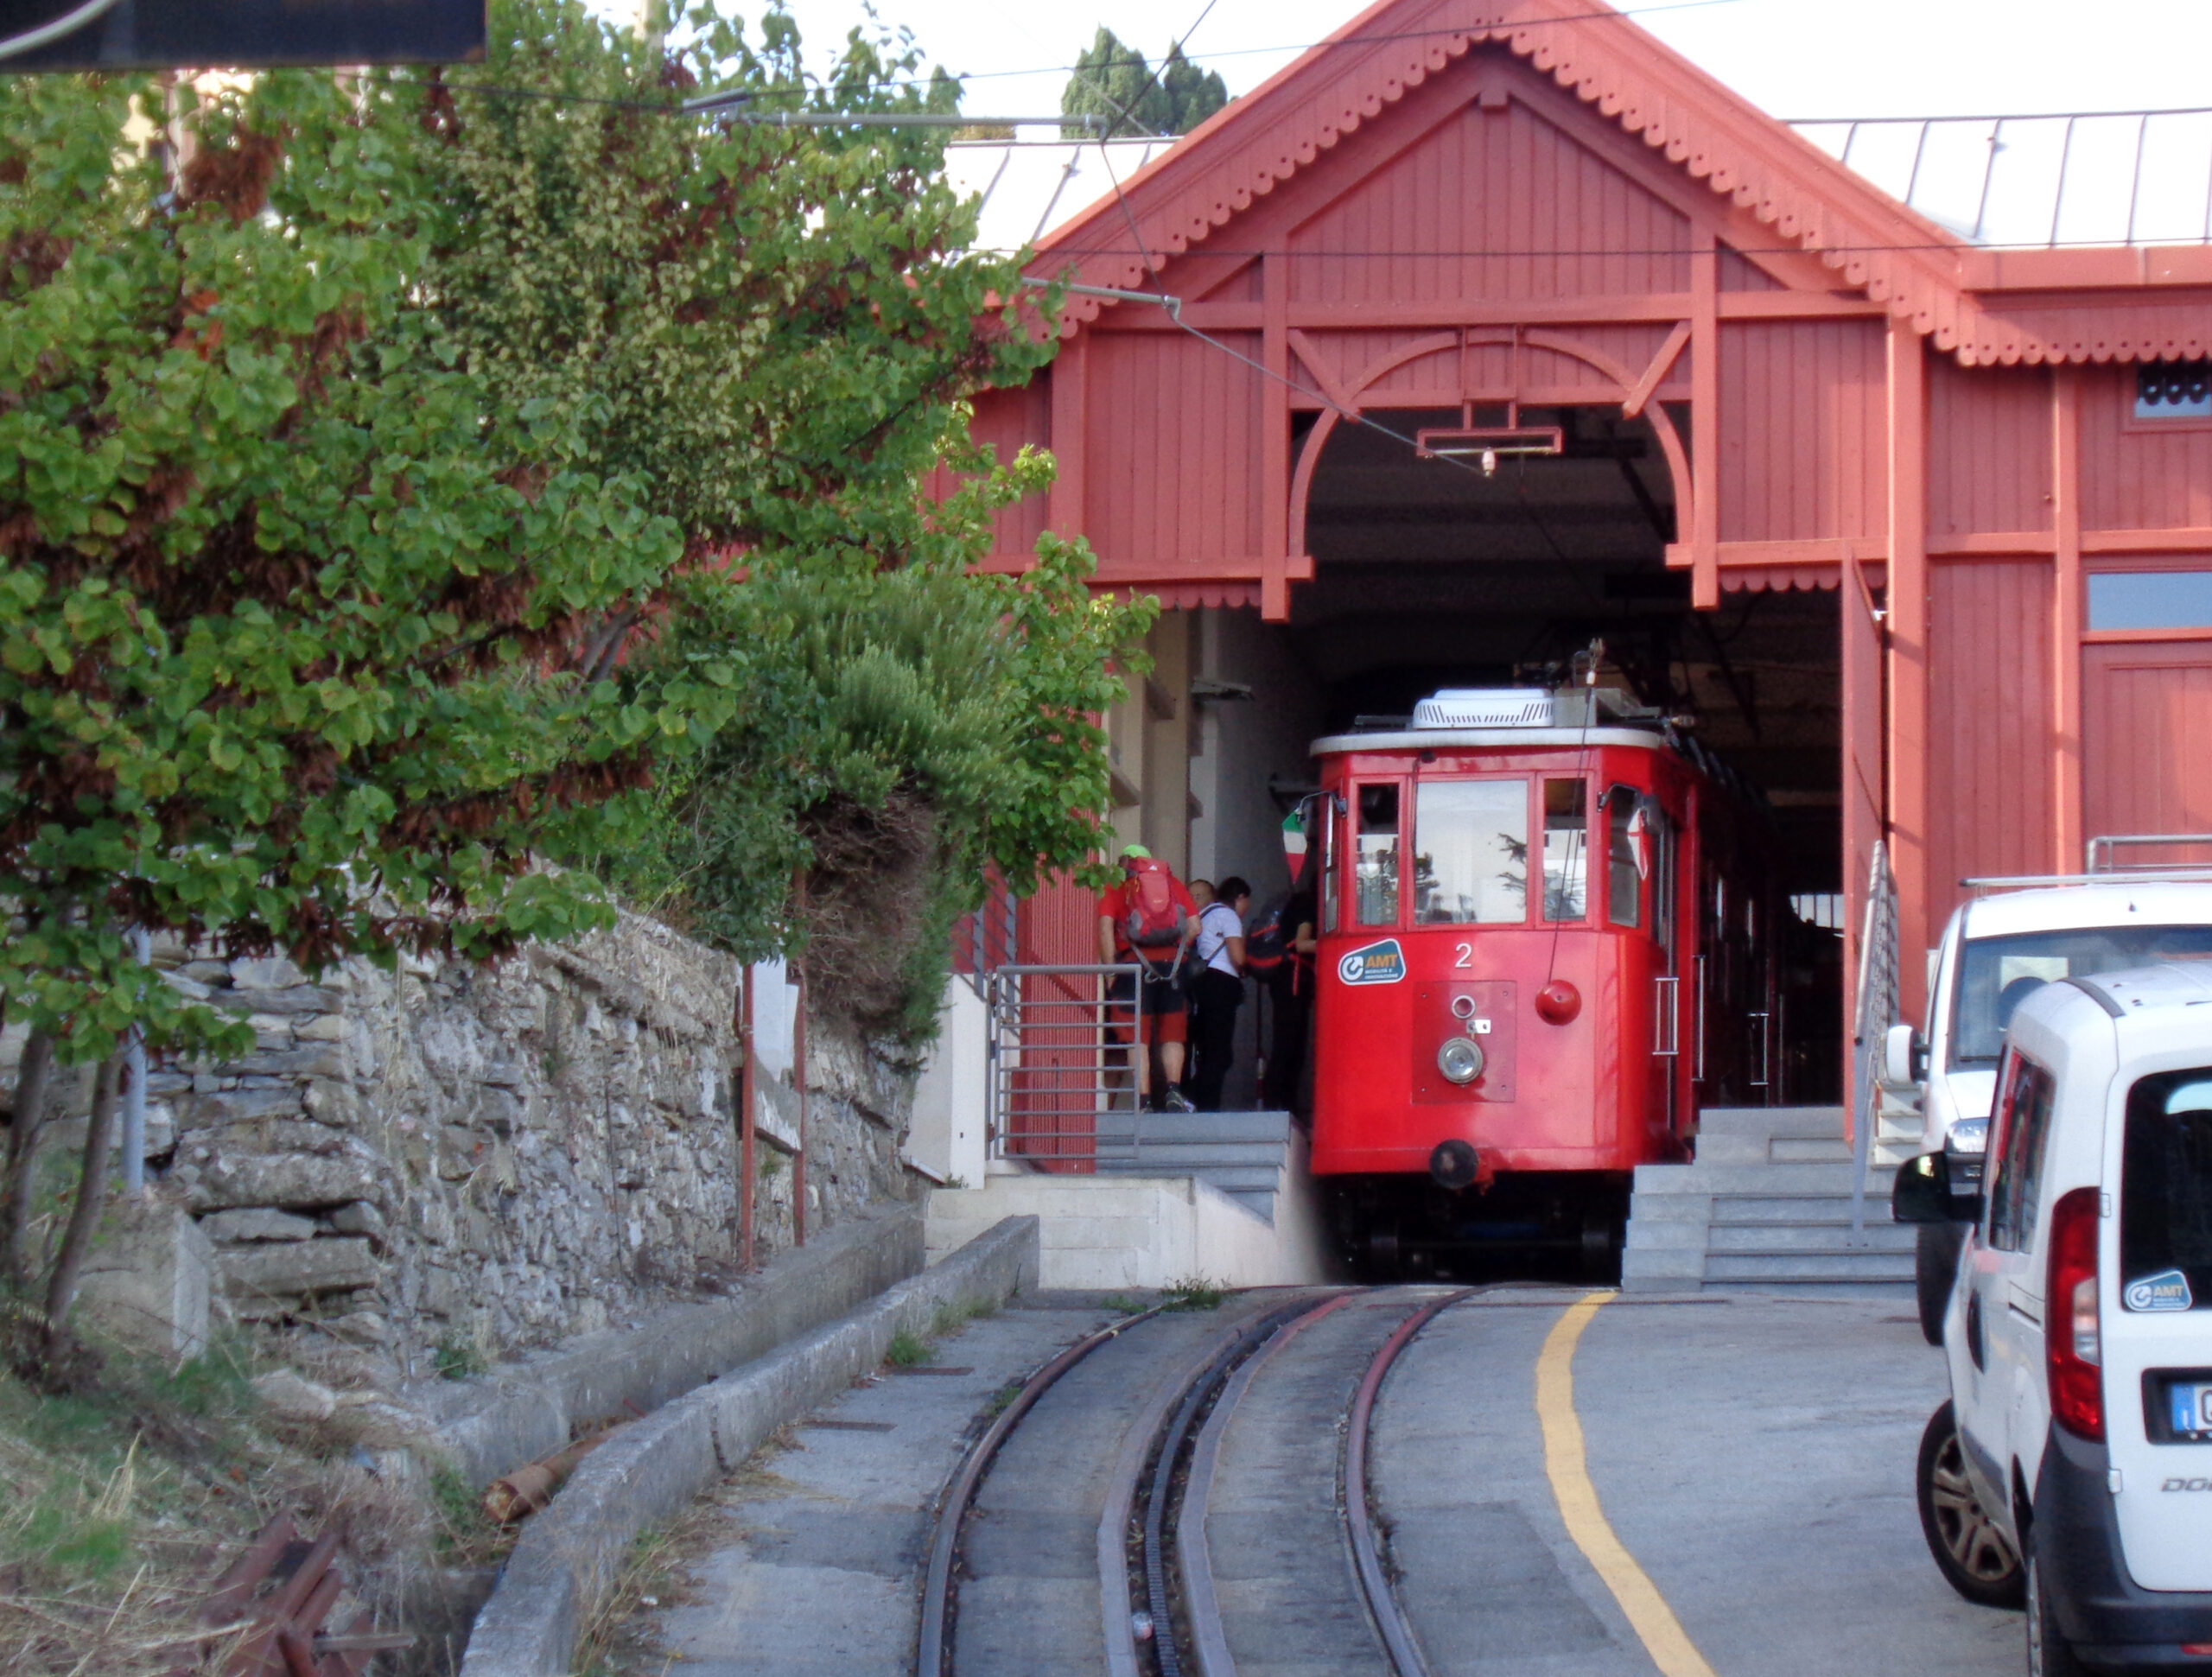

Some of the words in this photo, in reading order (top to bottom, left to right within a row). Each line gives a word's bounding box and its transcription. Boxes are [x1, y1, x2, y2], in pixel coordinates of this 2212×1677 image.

[1365, 954, 1398, 969] AMT
[1455, 943, 1471, 968] 2
[2154, 1286, 2184, 1297] AMT
[2161, 1478, 2212, 1492] DO
